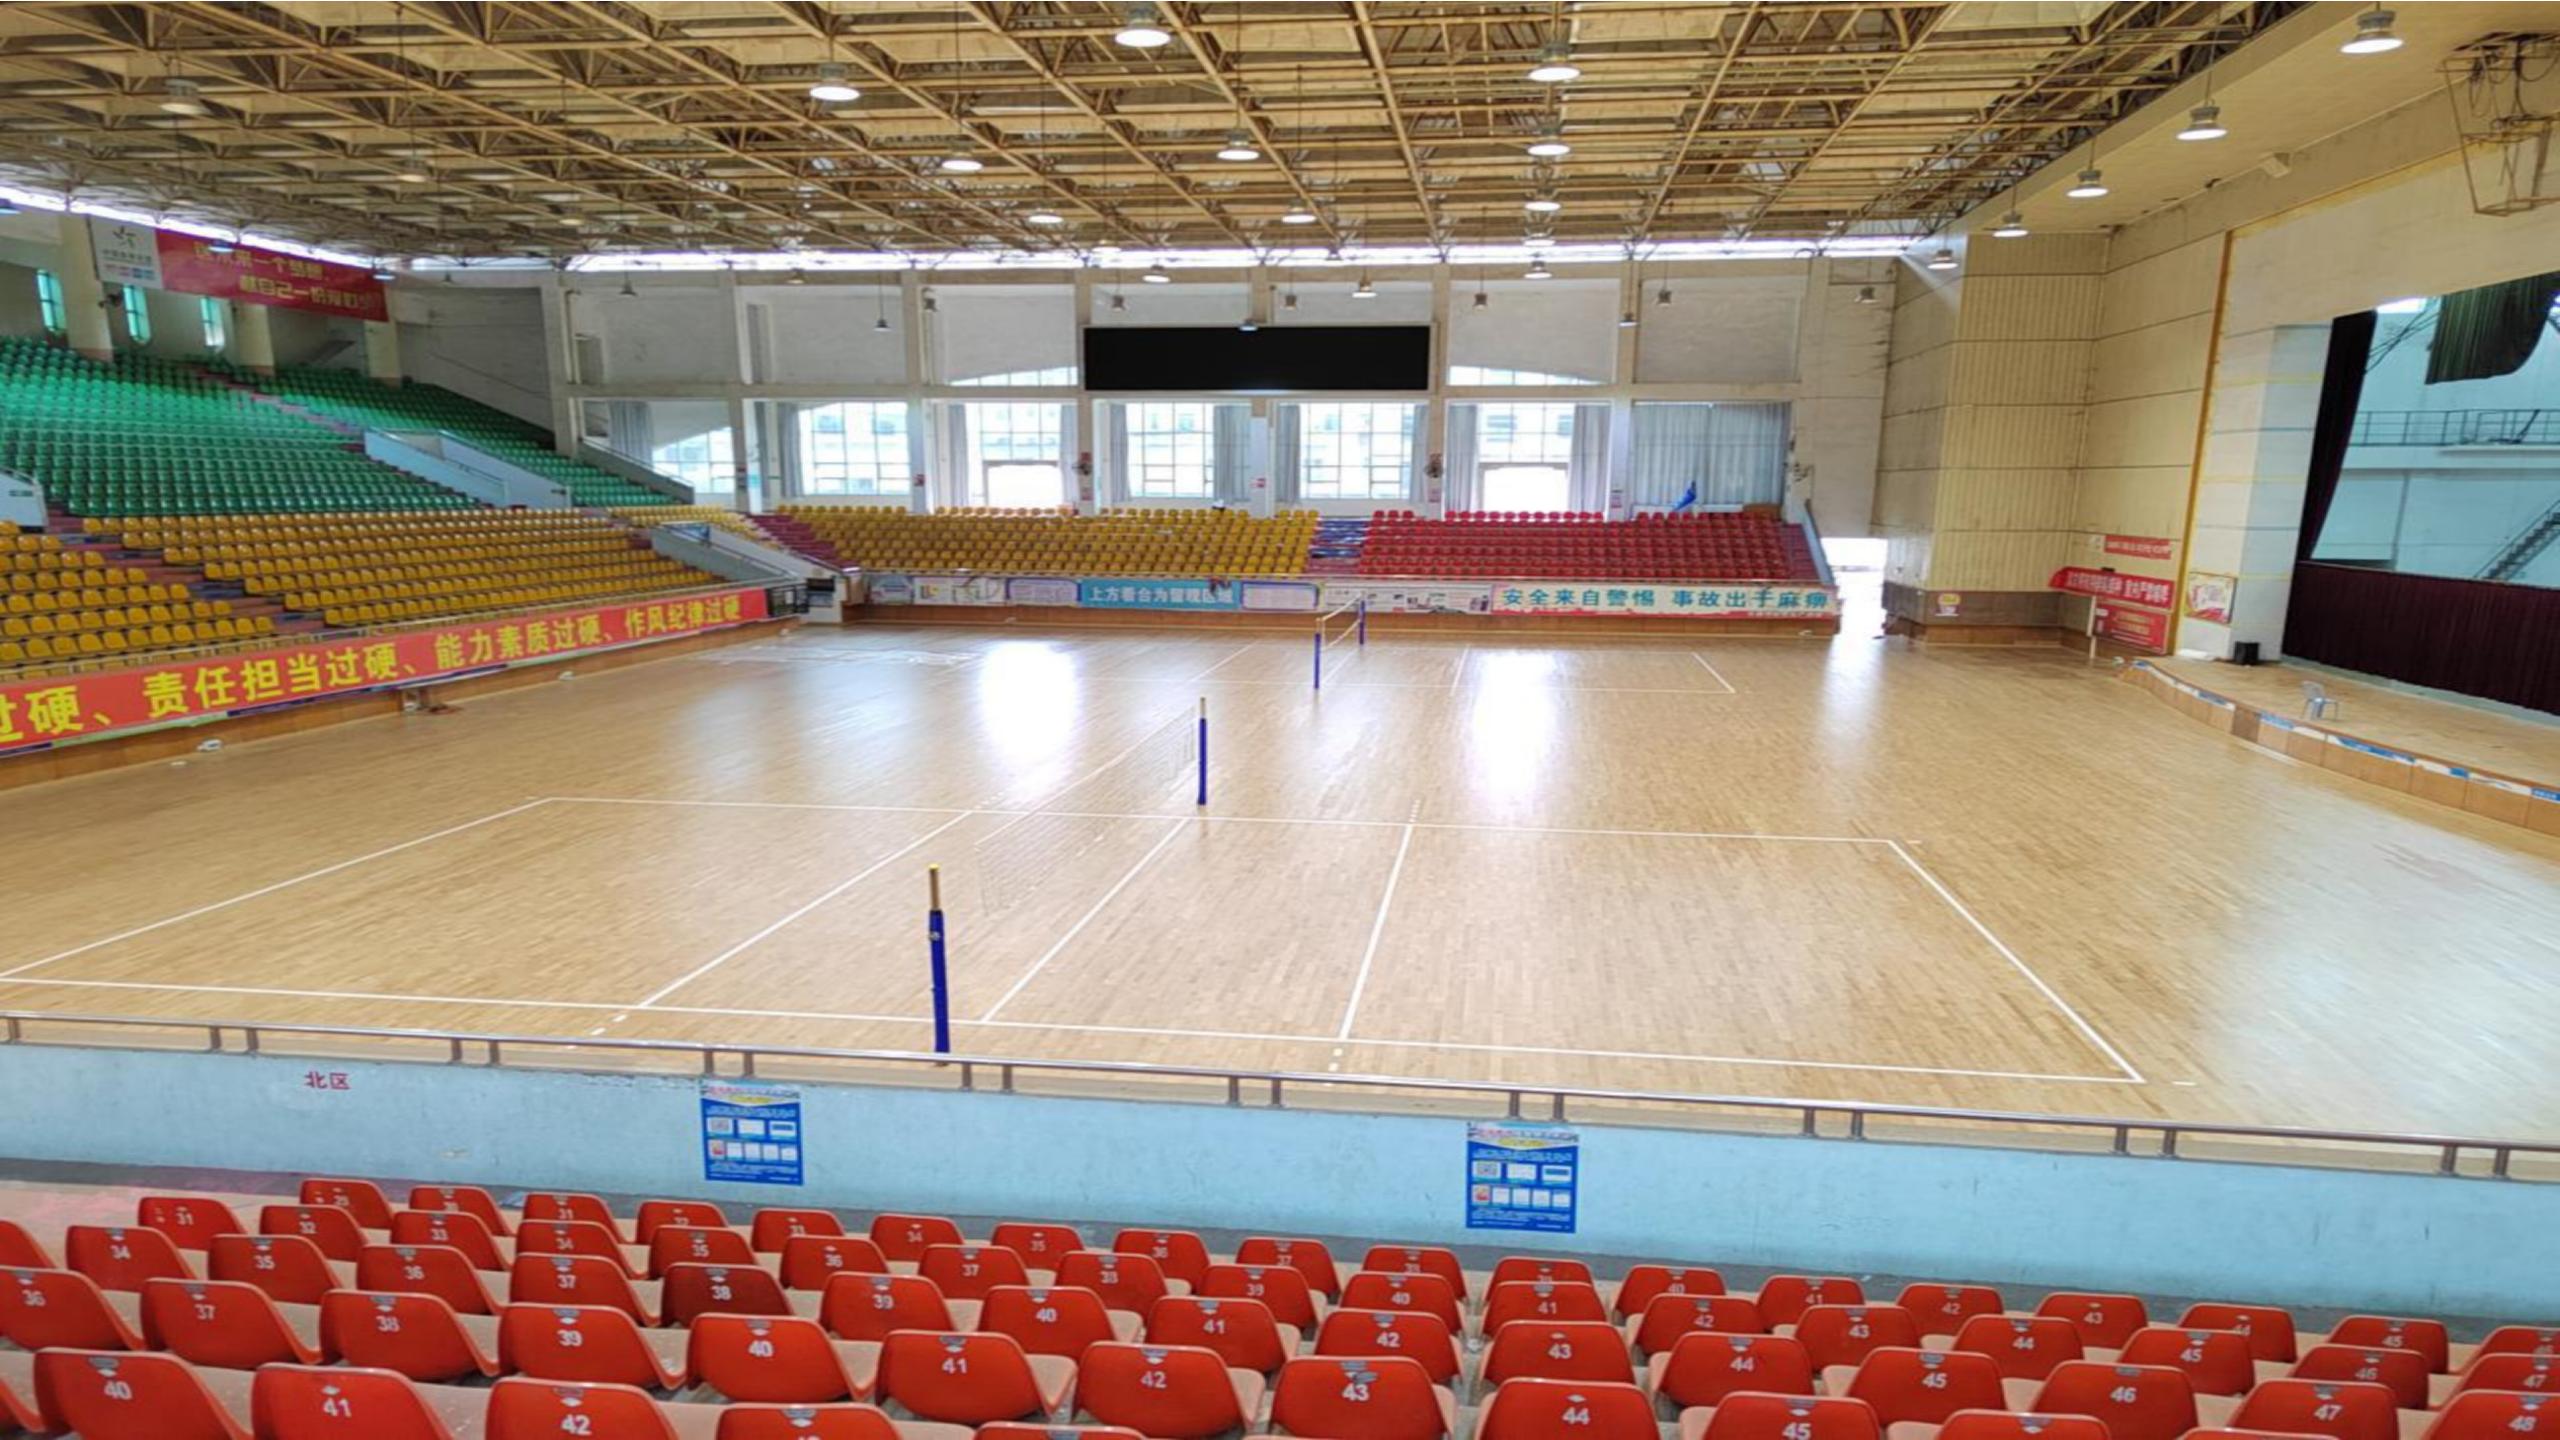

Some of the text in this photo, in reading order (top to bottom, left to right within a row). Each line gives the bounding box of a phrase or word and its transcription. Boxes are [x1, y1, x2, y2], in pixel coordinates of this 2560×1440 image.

[304, 1070, 352, 1090] 北区
[176, 1212, 194, 1225] 31
[691, 1245, 709, 1257] 35
[254, 1256, 275, 1270] 35
[962, 1264, 980, 1277] 37
[557, 1275, 577, 1289] 37
[710, 1285, 732, 1301] 38
[1391, 1292, 1411, 1305] 40
[194, 1304, 216, 1320] 37
[1035, 1308, 1057, 1323] 40
[1537, 1302, 1557, 1315] 41
[1203, 1319, 1227, 1335] 41
[1694, 1315, 1714, 1328] 42
[557, 1330, 583, 1347] 39
[1375, 1332, 1400, 1348] 42
[1848, 1325, 1870, 1339] 43
[748, 1342, 774, 1359] 40
[1547, 1343, 1573, 1360] 43
[2012, 1337, 2035, 1350] 44
[2179, 1349, 2202, 1362] 45
[941, 1359, 968, 1374] 41
[1729, 1356, 1755, 1372] 44
[1139, 1372, 1167, 1390] 42
[1921, 1373, 1948, 1390] 45
[2522, 1374, 2547, 1387] 47
[103, 1382, 133, 1400] 40
[1341, 1385, 1370, 1401] 43
[2110, 1387, 2138, 1403] 46
[322, 1400, 353, 1417] 41
[1562, 1408, 1591, 1424] 44
[2313, 1405, 2342, 1421] 47
[560, 1415, 592, 1435] 42
[1782, 1424, 1812, 1440] 45
